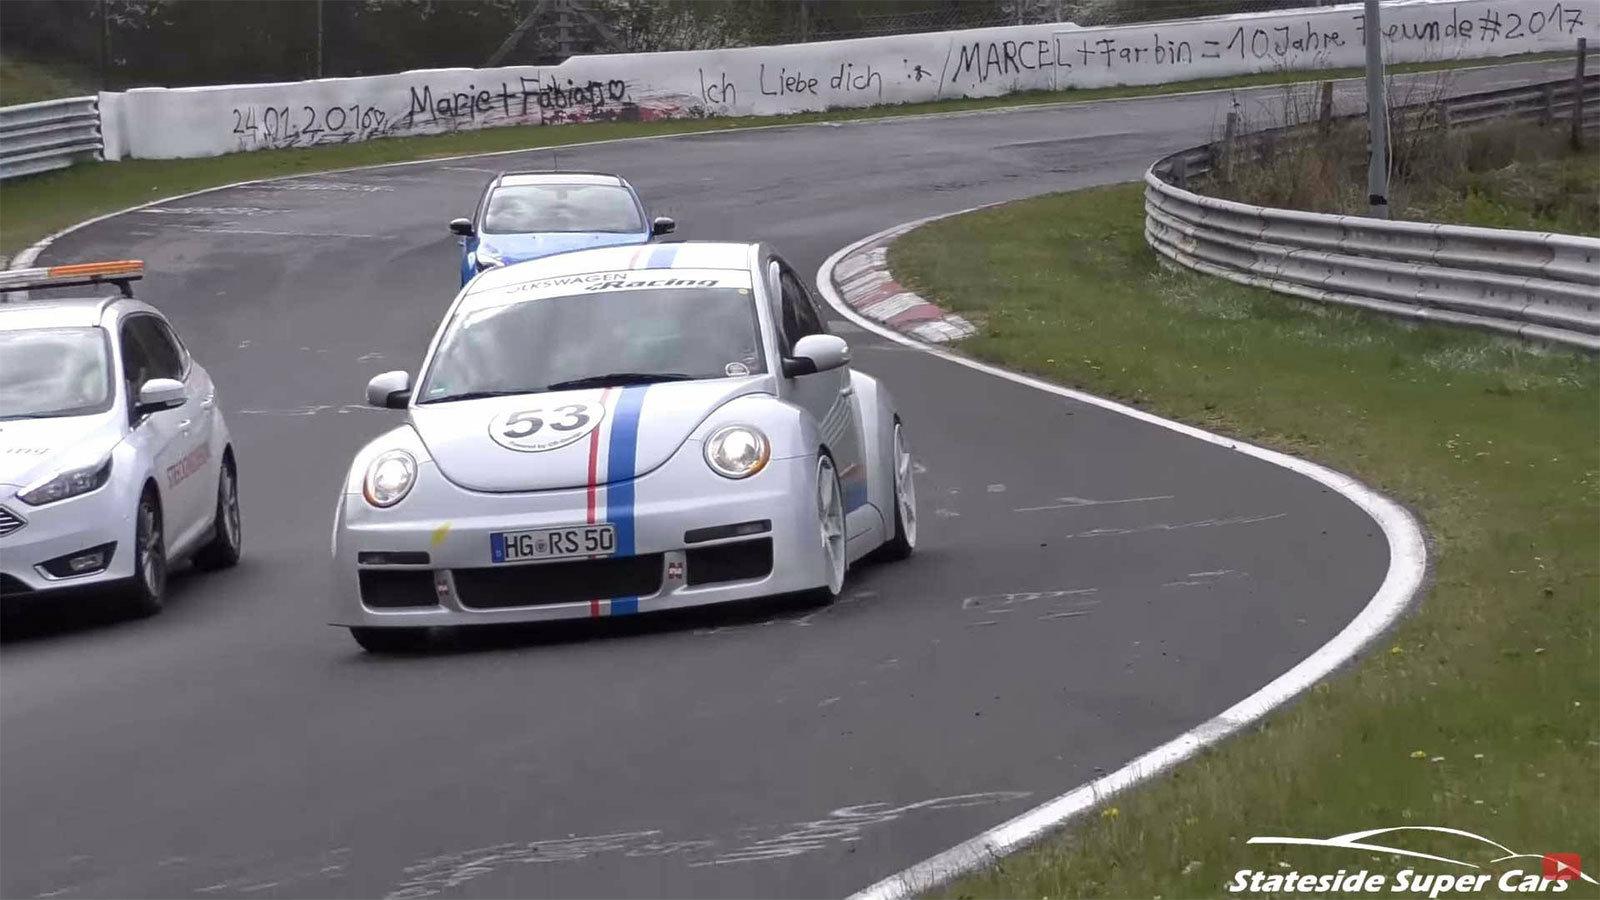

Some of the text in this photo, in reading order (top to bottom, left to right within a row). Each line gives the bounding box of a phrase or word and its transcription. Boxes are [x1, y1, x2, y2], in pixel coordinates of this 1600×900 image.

[699, 63, 882, 105] Ich Liebe dich
[503, 404, 590, 438] 53
[504, 528, 613, 558] HG RS 50
